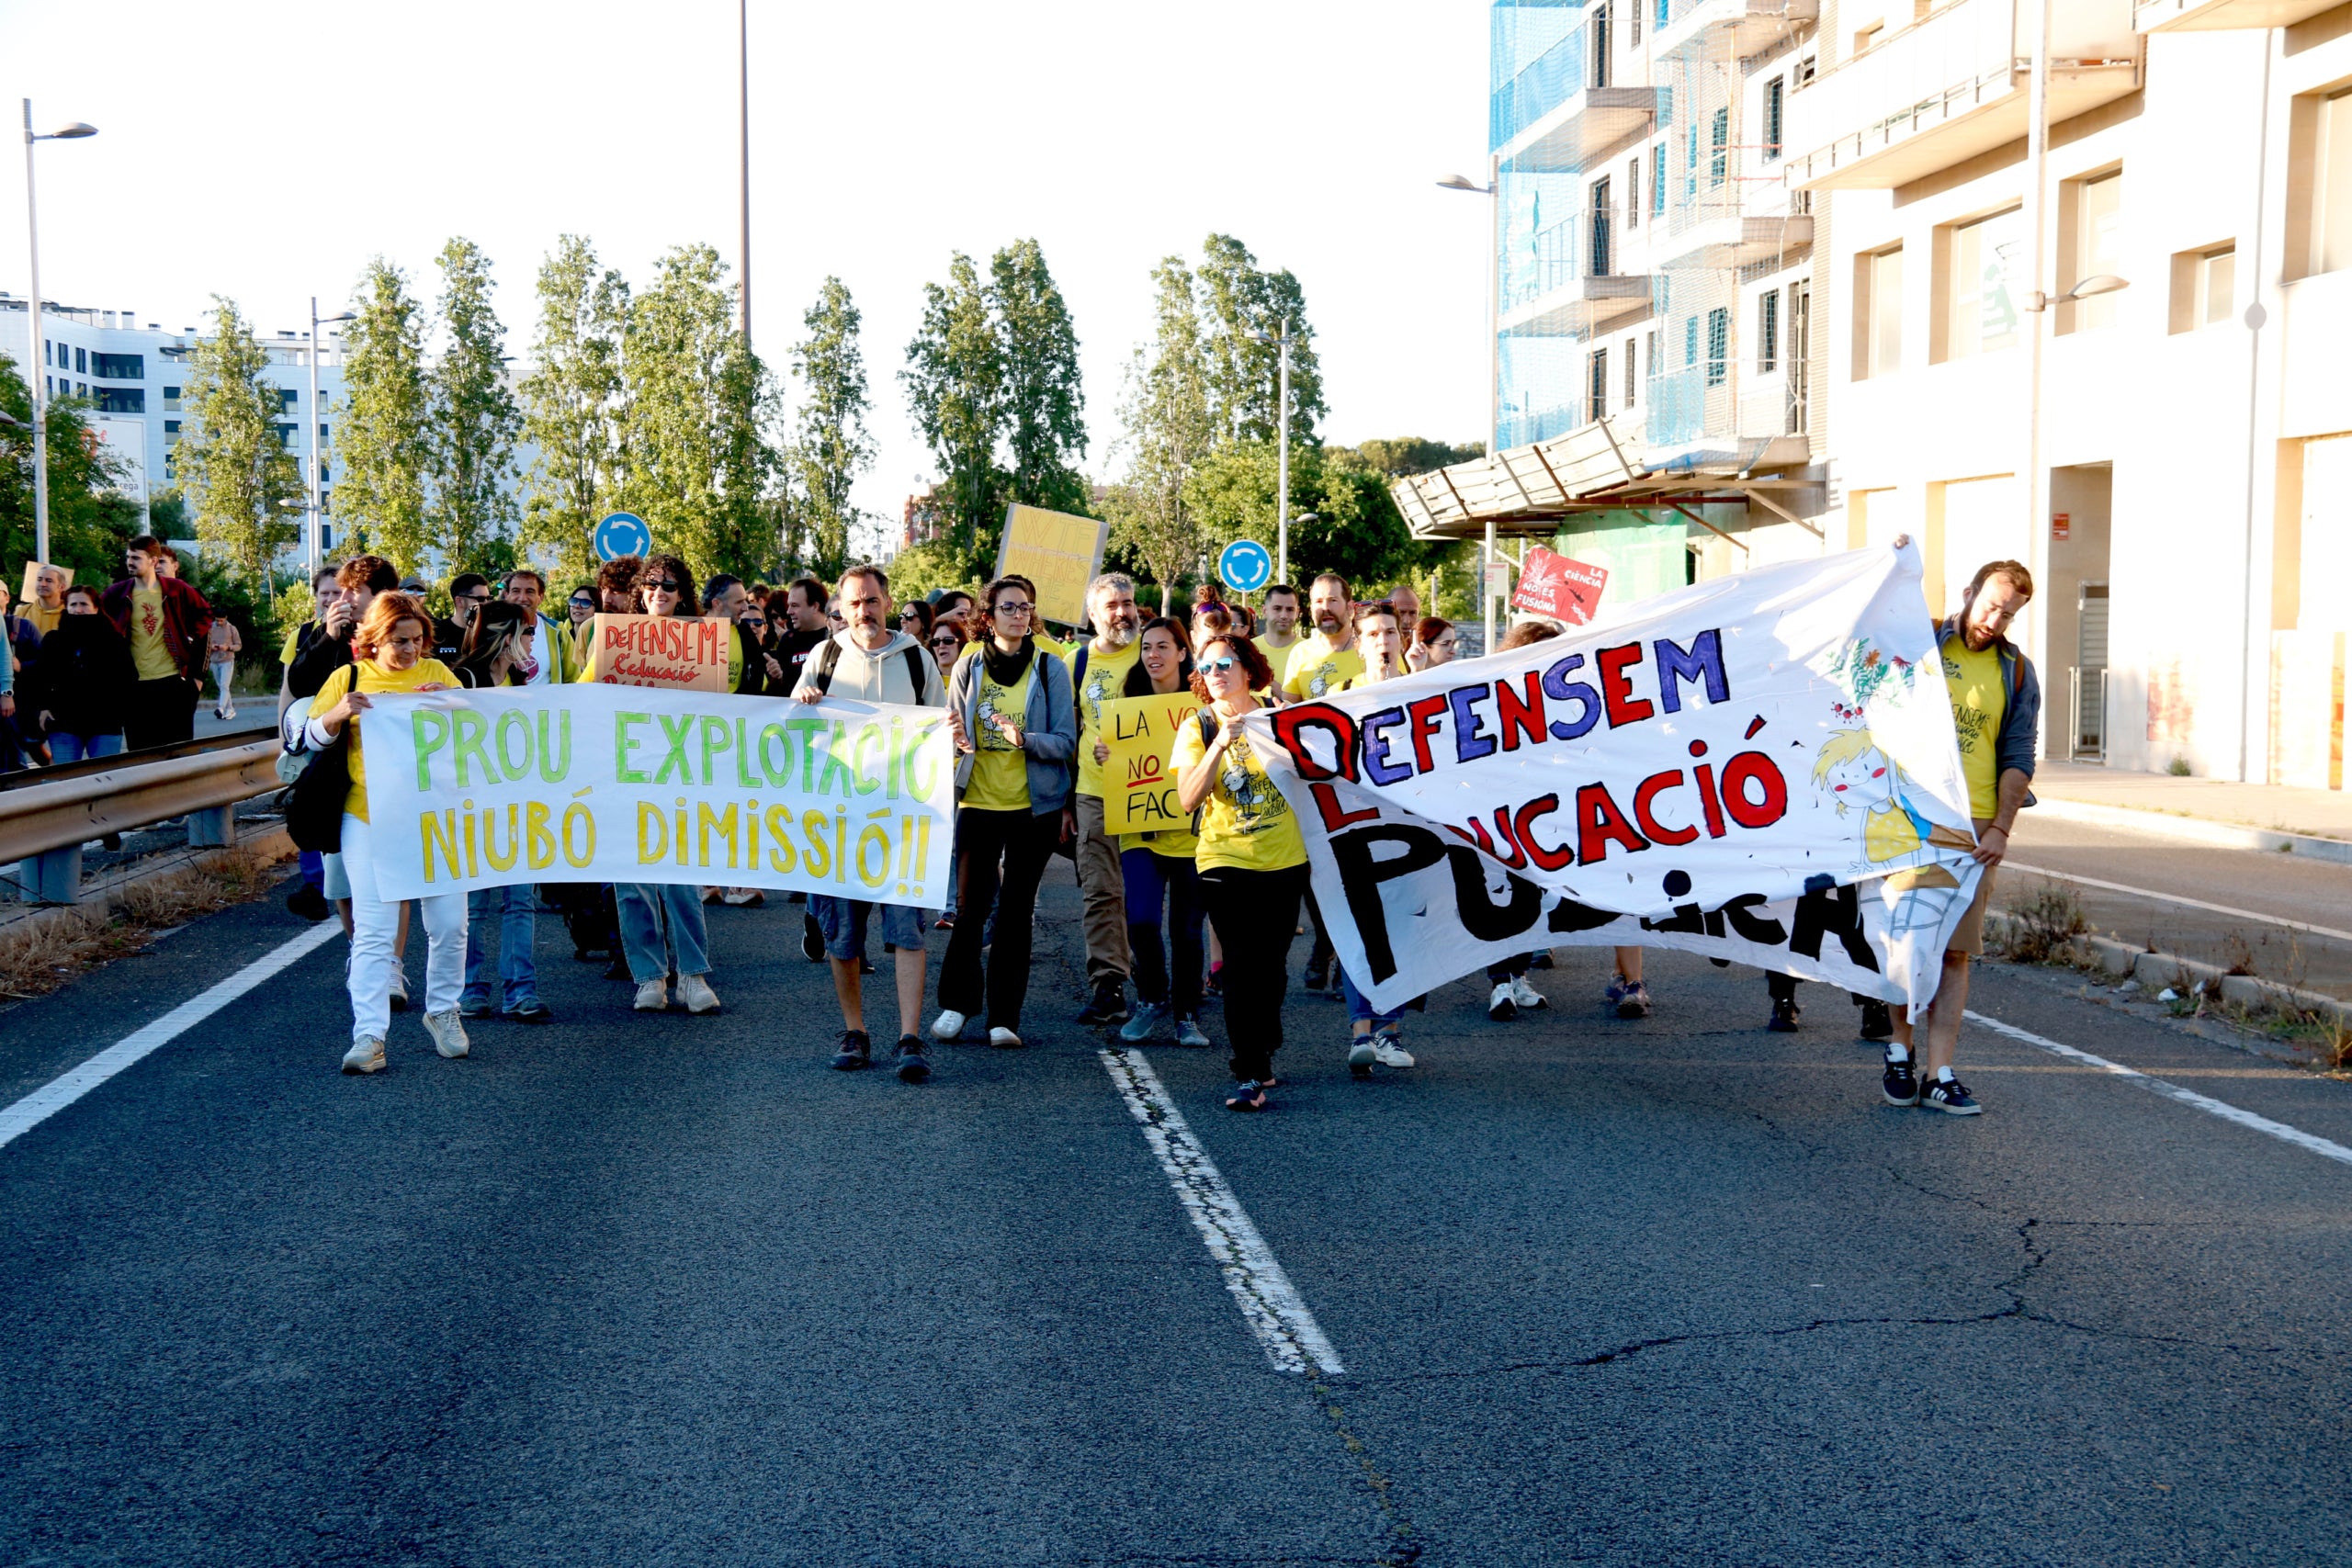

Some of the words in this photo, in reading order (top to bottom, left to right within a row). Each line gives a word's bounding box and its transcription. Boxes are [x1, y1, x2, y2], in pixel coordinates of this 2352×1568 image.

[1522, 582, 1539, 592] NO
[1589, 567, 1604, 580] LA
[1515, 593, 1556, 613] FUSIONA
[605, 618, 718, 666] DEFENSEM
[1266, 627, 1730, 787] DEFENSEM
[1115, 709, 1150, 740] LA
[411, 708, 571, 792] PROU
[1127, 753, 1160, 780] NO
[1126, 788, 1191, 823] FAC
